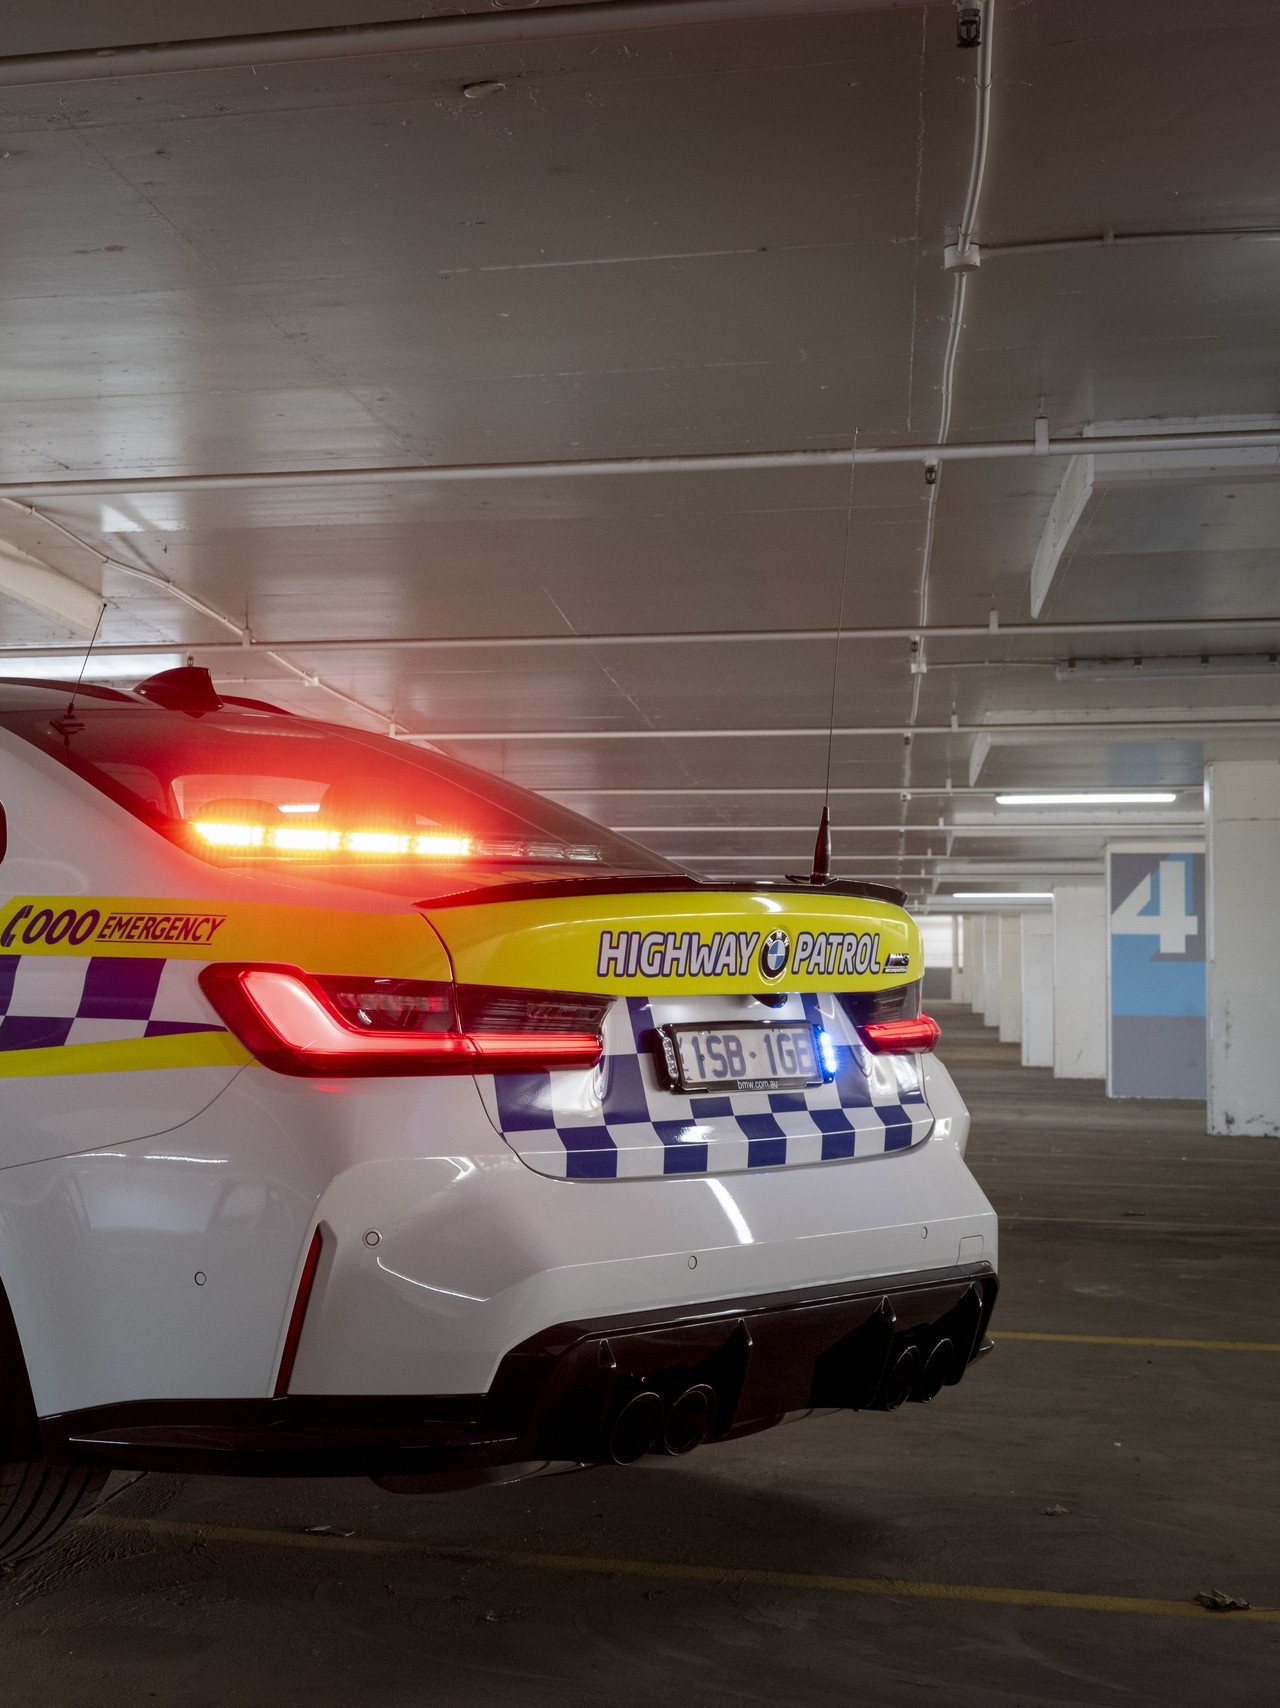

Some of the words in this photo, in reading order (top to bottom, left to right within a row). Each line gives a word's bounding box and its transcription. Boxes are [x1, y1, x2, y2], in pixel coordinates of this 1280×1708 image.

[1111, 861, 1198, 953] 4
[96, 915, 226, 942] EMERGENCY
[597, 931, 760, 977] HIGHWAY
[792, 932, 881, 975] PATROL
[737, 1079, 779, 1090] bmw.com.au
